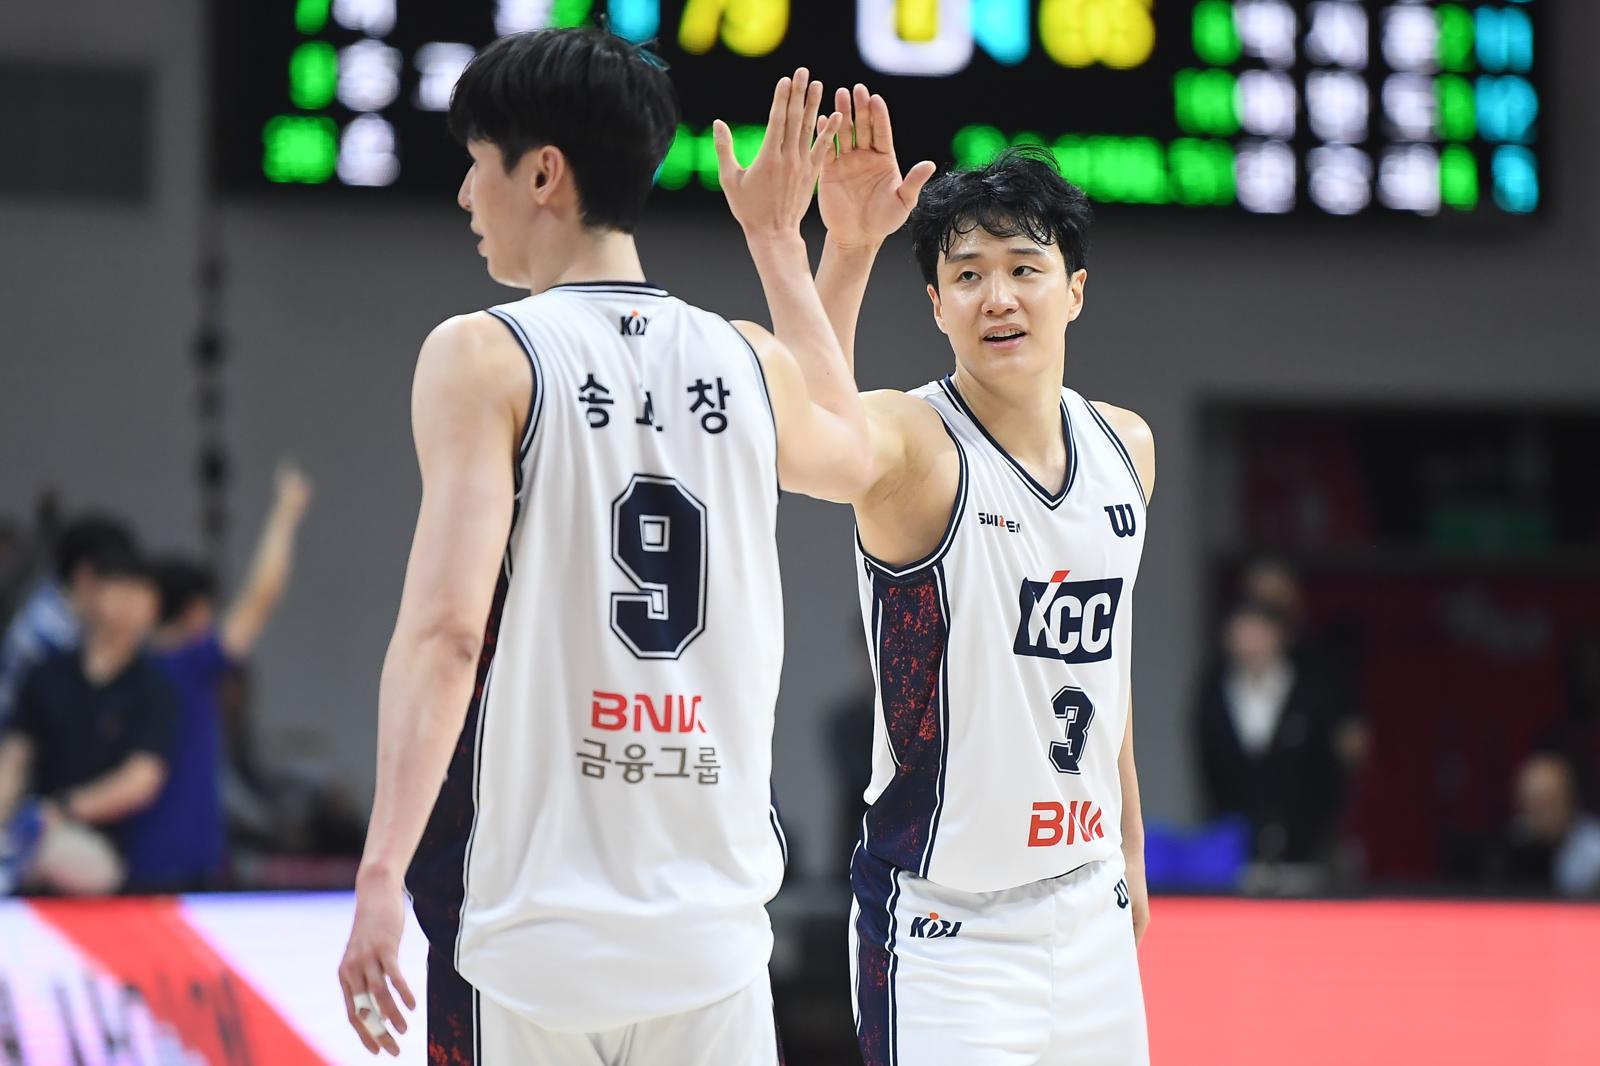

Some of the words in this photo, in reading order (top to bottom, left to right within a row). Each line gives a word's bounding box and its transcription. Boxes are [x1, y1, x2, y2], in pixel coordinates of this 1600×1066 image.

[610, 473, 707, 660] 9
[1026, 569, 1113, 656] KCC
[591, 690, 706, 734] BNK
[1048, 685, 1096, 775] 3
[576, 738, 721, 785] 금융그룹
